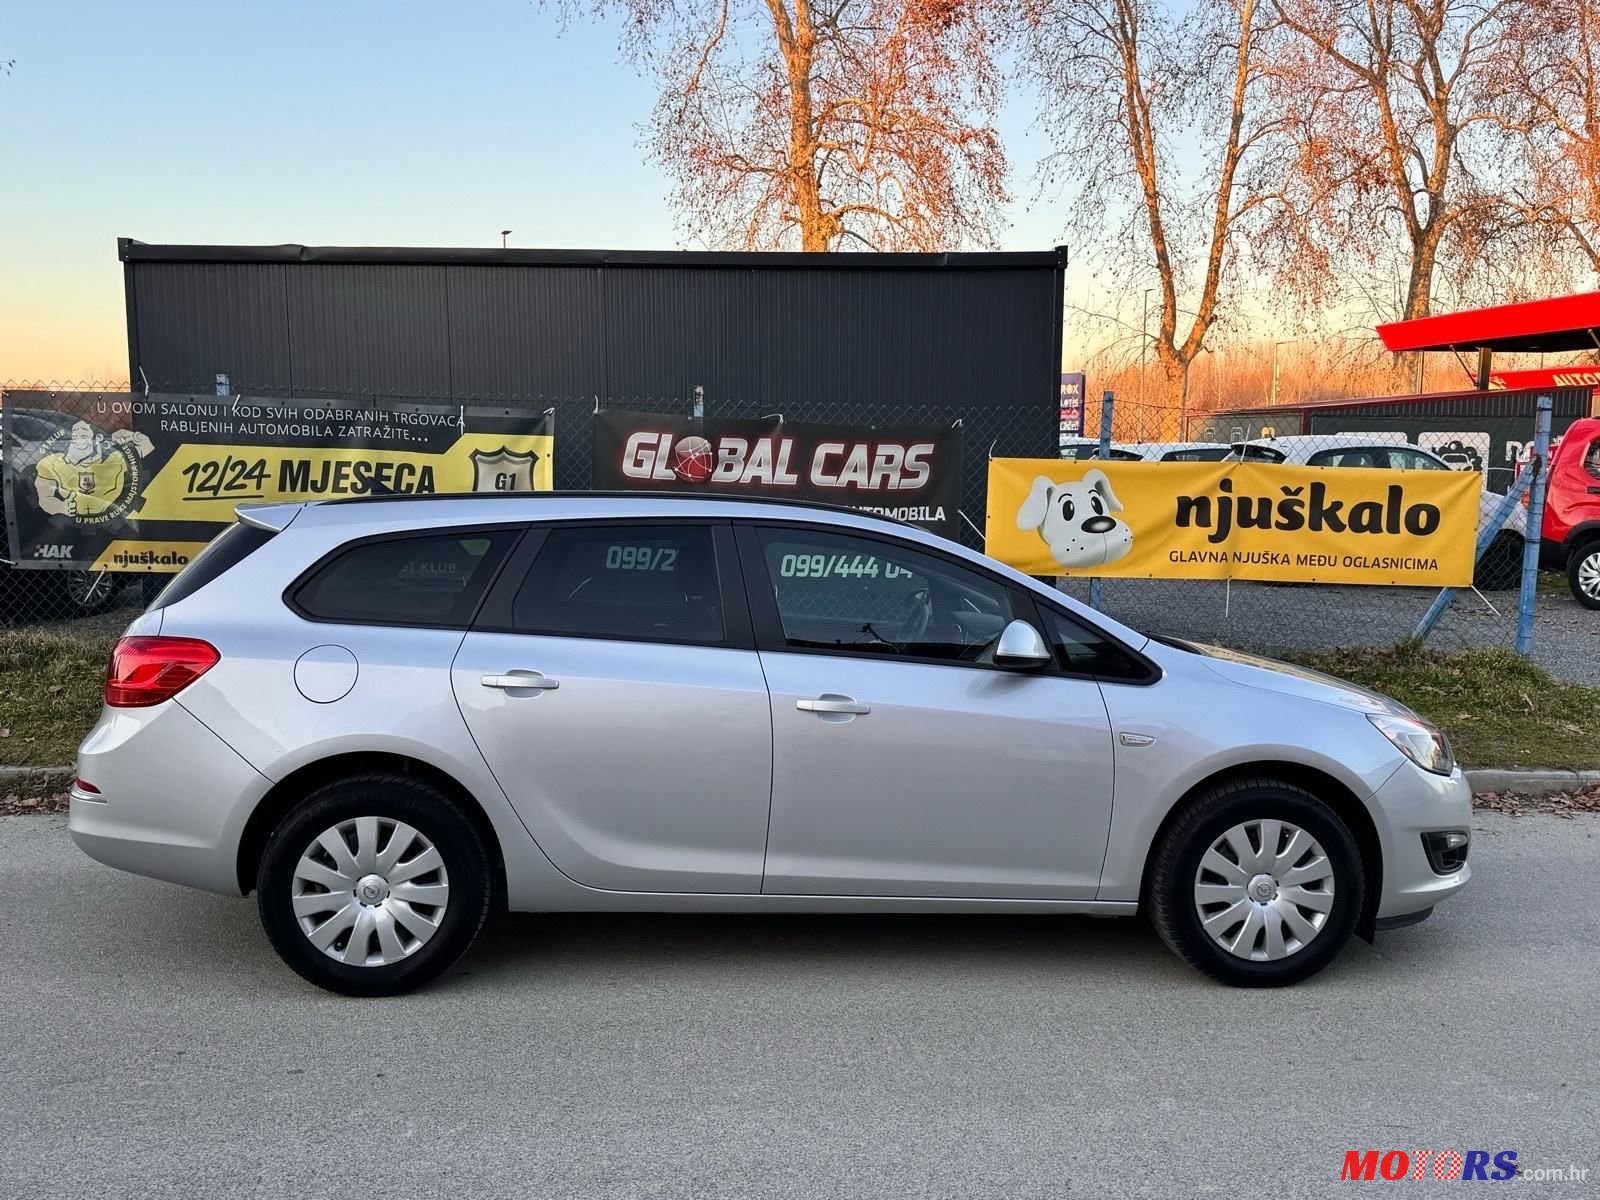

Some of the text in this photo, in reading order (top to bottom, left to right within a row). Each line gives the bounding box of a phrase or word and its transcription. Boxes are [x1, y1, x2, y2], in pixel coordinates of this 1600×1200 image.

[97, 402, 466, 428] U OVOM SALONU I KOD SVIH ODABRANIH TRGOVACA
[161, 420, 429, 442] RABLJENIH AUTOMOBILA ZATRAŽITE...
[182, 455, 271, 496] 12/24
[809, 442, 935, 490] CARS
[494, 472, 517, 491] G1
[84, 513, 110, 524] PRAVE
[110, 504, 128, 519] RUKE
[126, 465, 139, 504] MAJSTORA
[1175, 478, 1441, 544] njuškalo
[113, 550, 189, 568] njuškalo
[780, 554, 879, 578] 099/444
[1169, 550, 1439, 571] GLAVNA NJUŠKA MEĐU OGLASNICIMA
